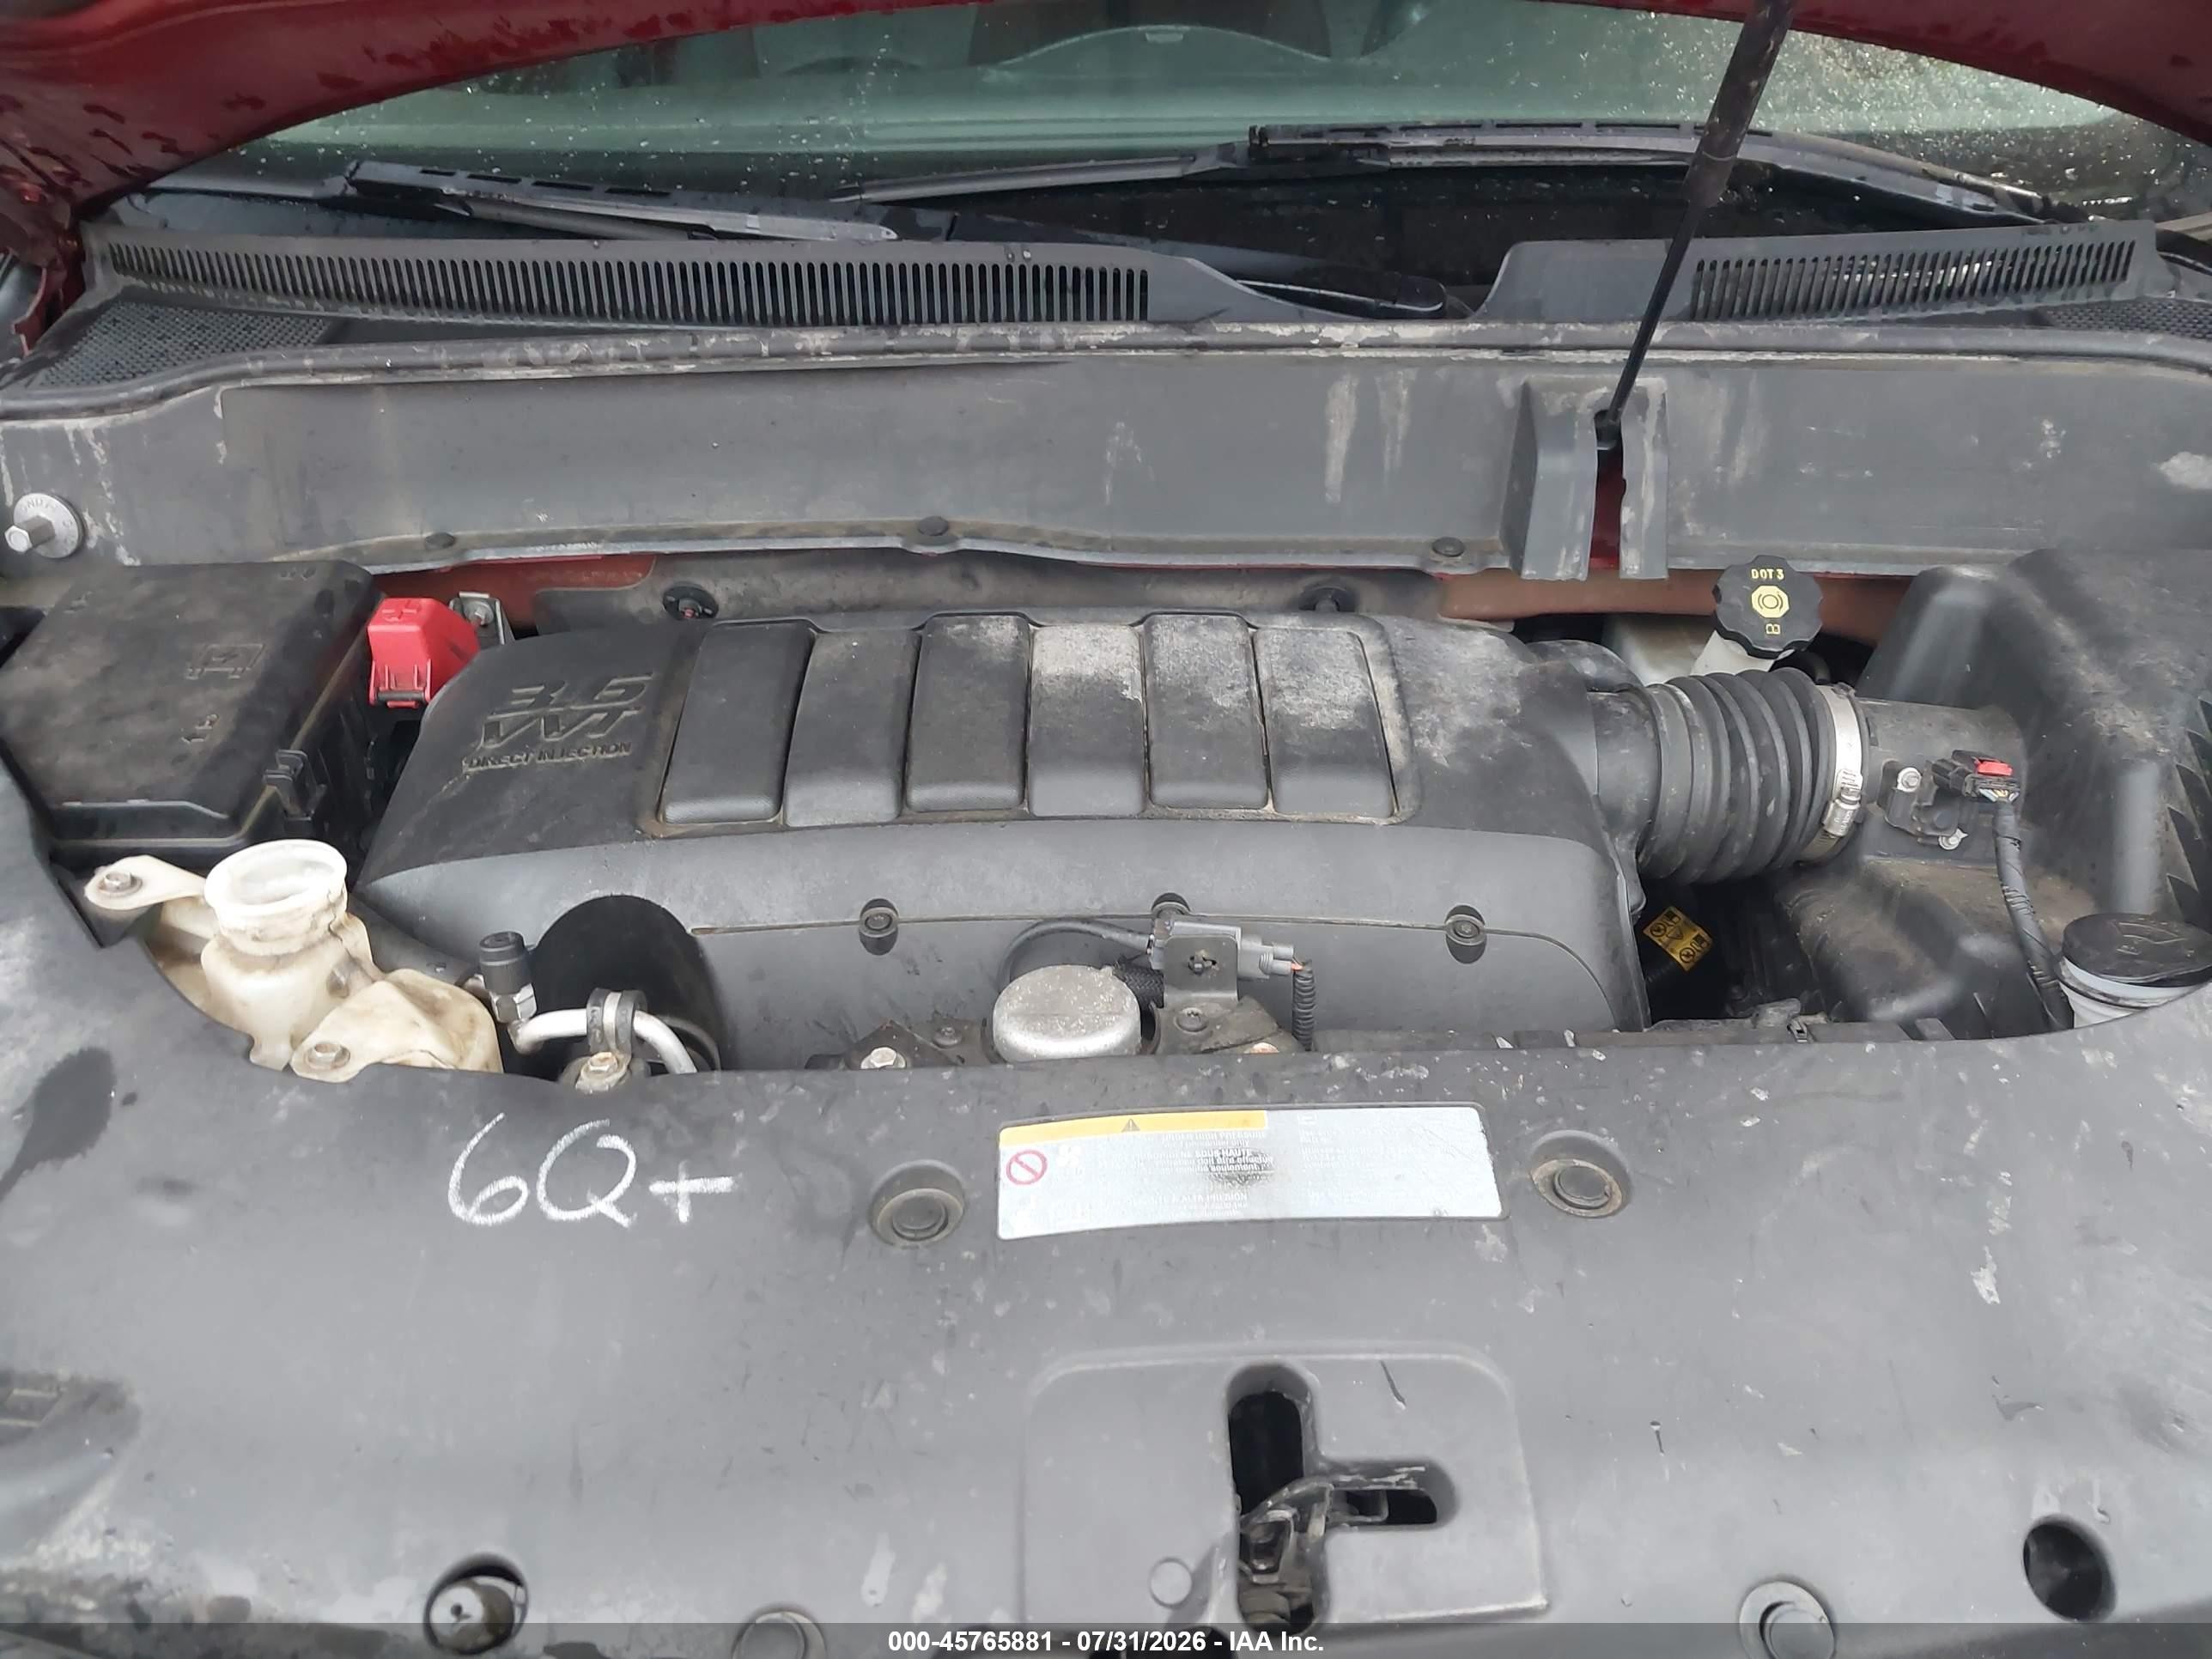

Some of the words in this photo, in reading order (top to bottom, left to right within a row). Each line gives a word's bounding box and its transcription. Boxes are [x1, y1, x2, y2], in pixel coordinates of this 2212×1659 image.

[1751, 568, 1774, 580] DOT
[1777, 569, 1784, 580] 3
[466, 753, 532, 771] DIRECT
[538, 741, 632, 764] INJECTION
